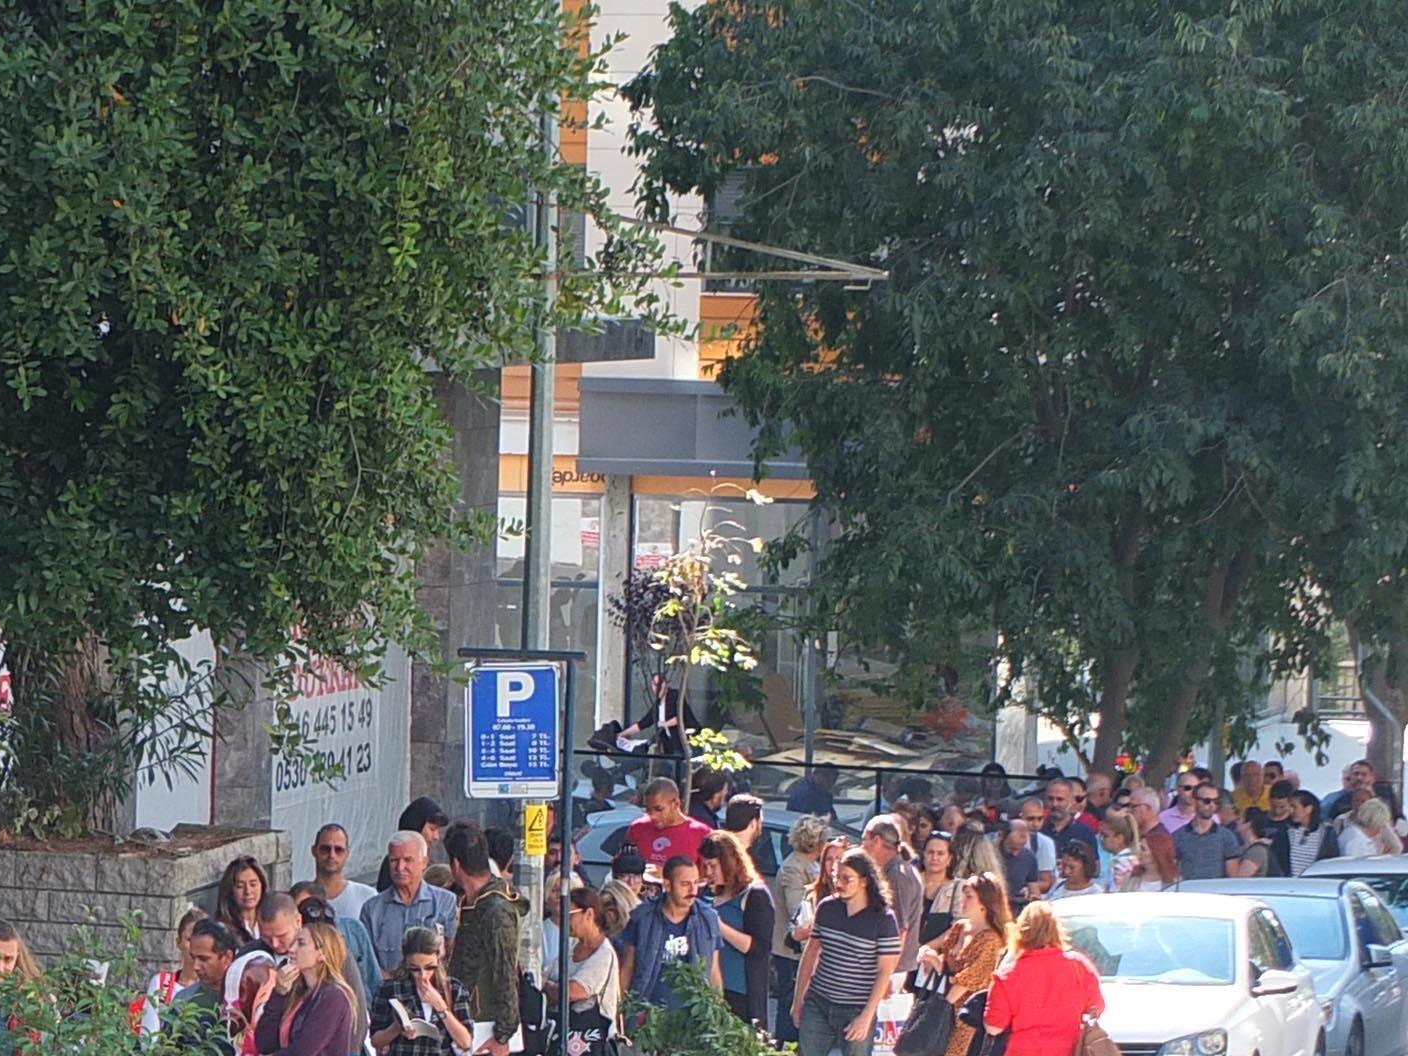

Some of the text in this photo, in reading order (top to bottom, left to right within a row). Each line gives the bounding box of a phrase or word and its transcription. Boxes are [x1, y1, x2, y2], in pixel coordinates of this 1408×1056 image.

[497, 672, 535, 717] P
[314, 706, 336, 736] 445
[341, 702, 355, 732] 15
[358, 698, 372, 728] 49
[357, 742, 372, 773] 23
